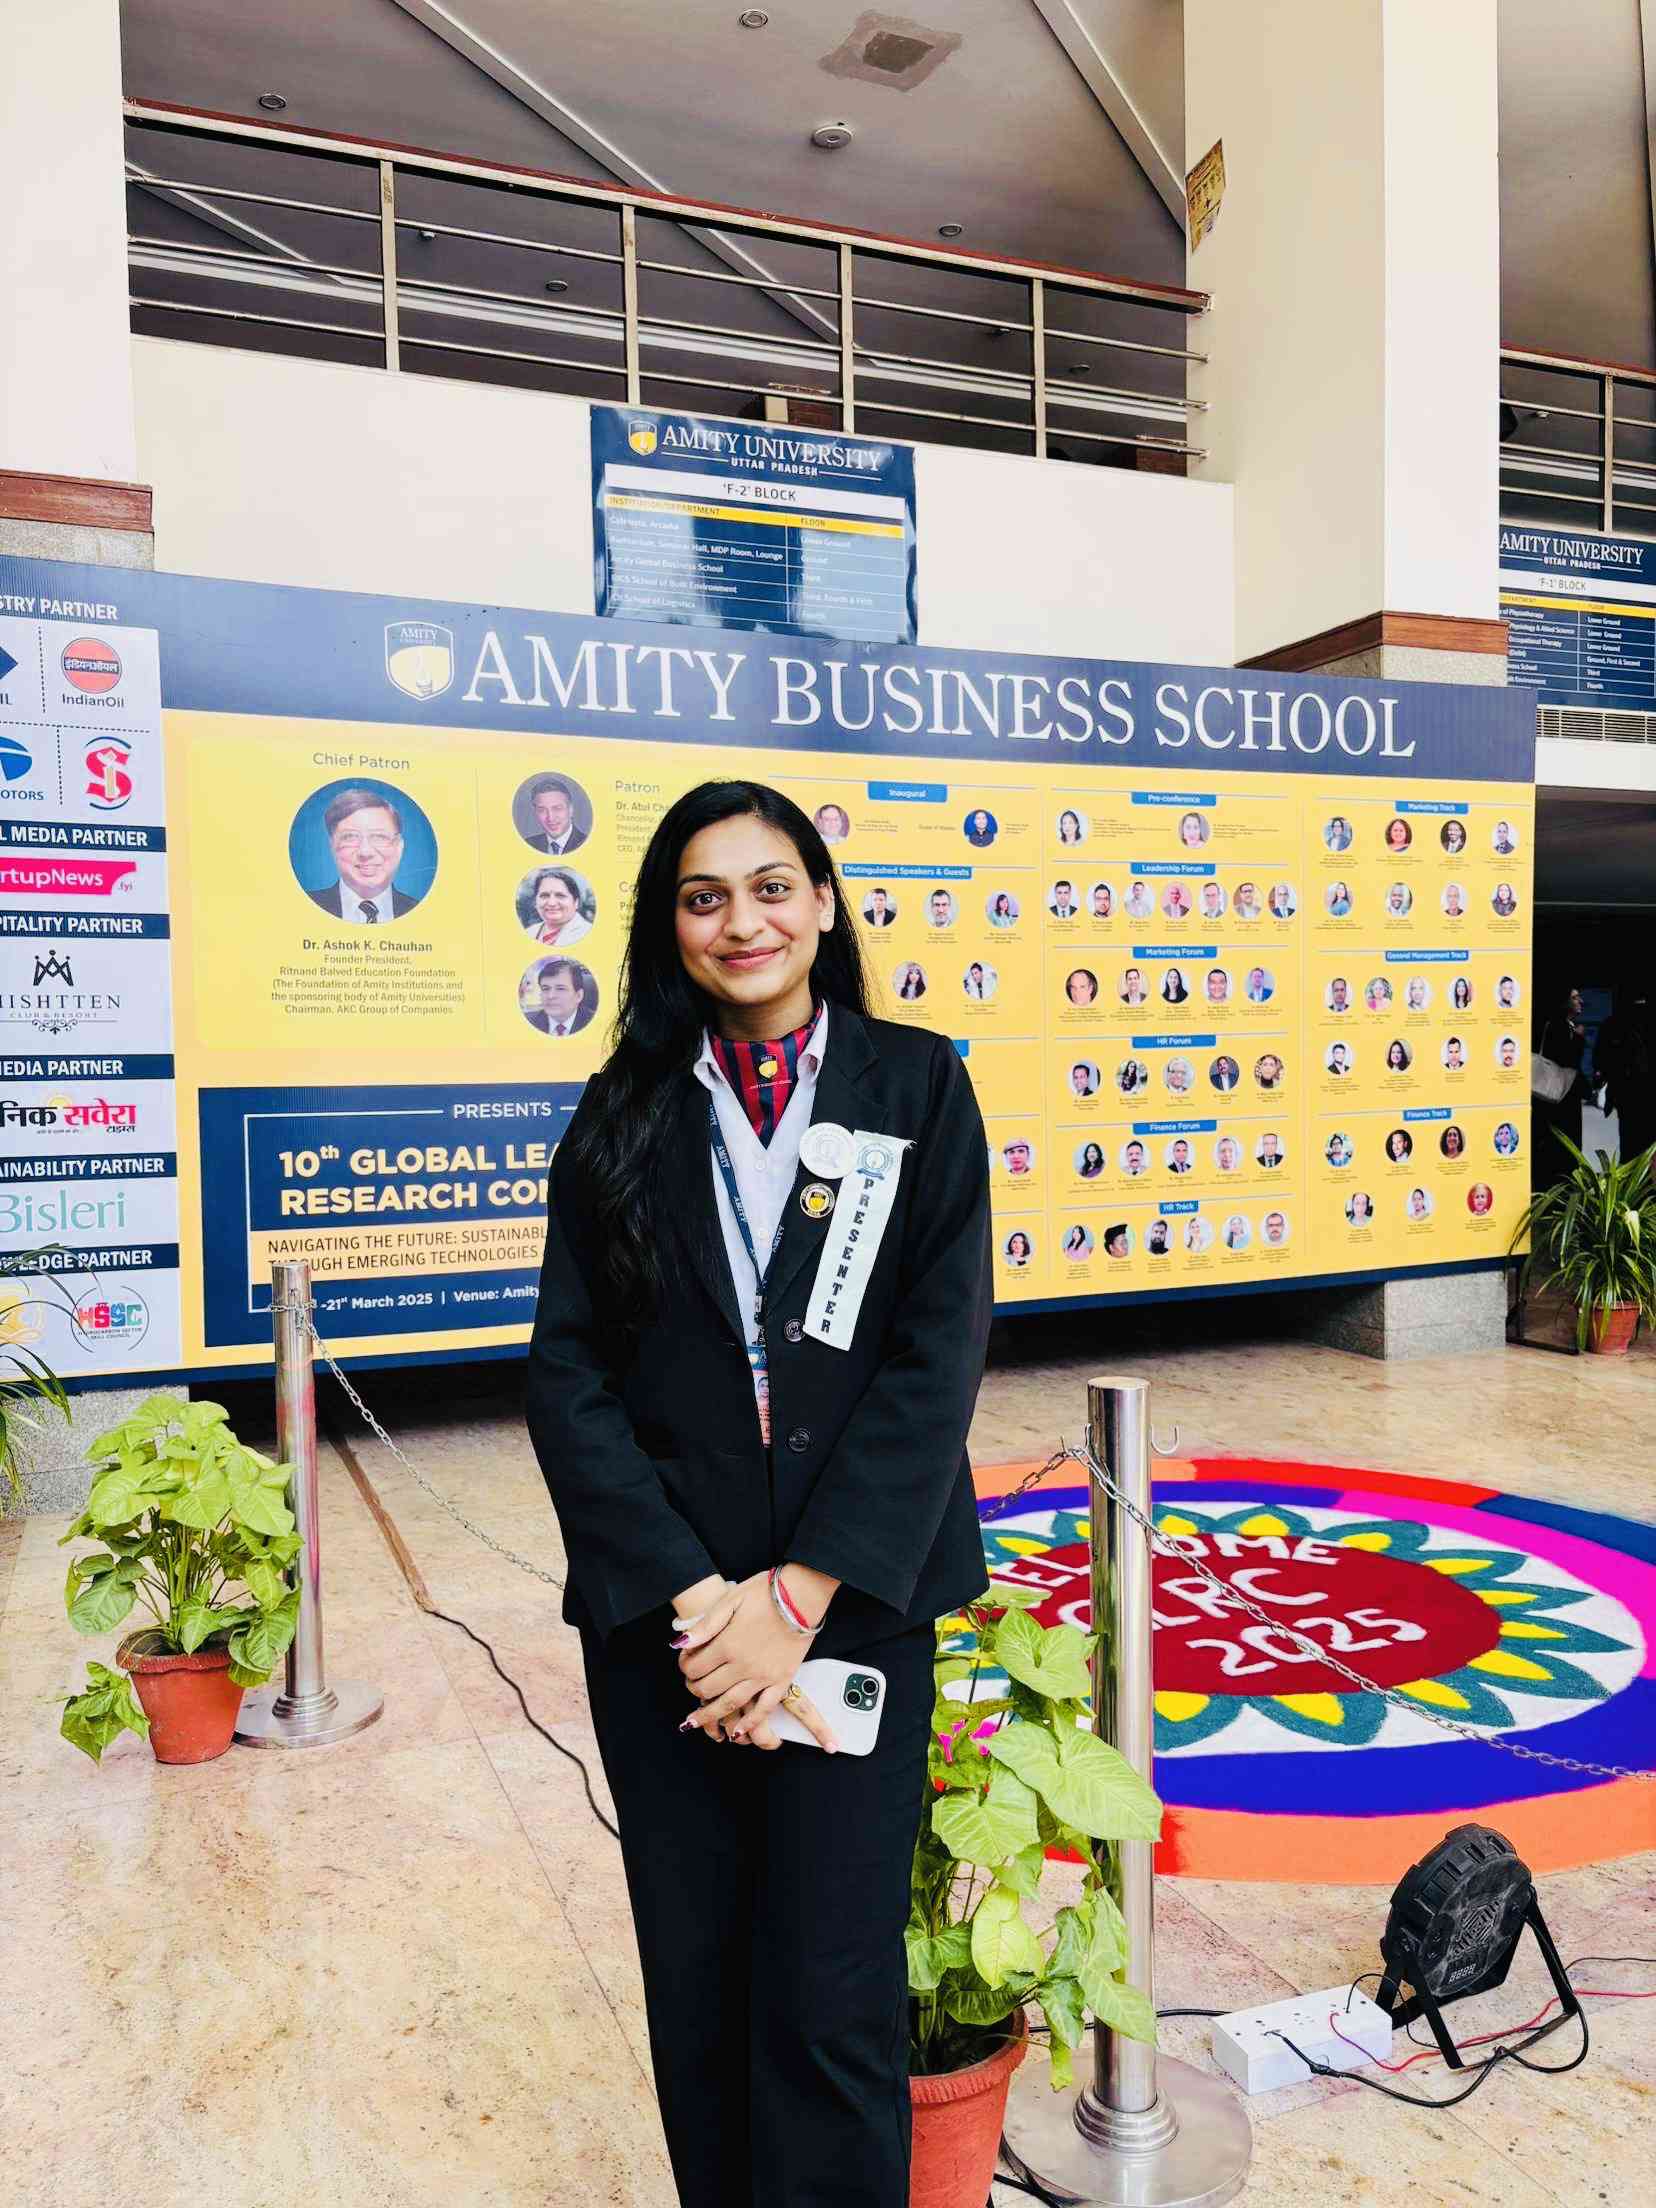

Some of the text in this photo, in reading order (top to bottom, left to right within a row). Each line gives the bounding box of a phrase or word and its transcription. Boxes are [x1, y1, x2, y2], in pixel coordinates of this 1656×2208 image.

[662, 425, 881, 471] AMITY UNIVERSITY
[731, 457, 818, 476] UTTAR PRADESH
[755, 486, 797, 501] BLOCK
[756, 549, 785, 562] Lounge
[1499, 532, 1644, 565] AMITY UNIVERSITY
[697, 562, 725, 574] School
[1570, 559, 1601, 570] PRADESH
[1558, 580, 1587, 591] BLOCK
[40, 598, 119, 621] PARTNER
[400, 627, 438, 640] AMITY
[62, 693, 125, 708] IndianOil
[462, 630, 1417, 758] AMITY BUSINESS SCHOOL
[312, 752, 411, 771] Chief Patron
[615, 780, 661, 794] Patron
[616, 801, 630, 811] Dr.
[11, 826, 69, 846] MEDIA
[71, 828, 149, 848] PARTNER
[844, 865, 898, 877] Distinguished
[1142, 863, 1204, 874] Leadership Forum
[67, 917, 143, 934] PARTNER
[303, 939, 433, 953] Dr. Ashok K. Chauhan
[1146, 948, 1205, 957] Marketing Forum
[324, 954, 364, 964] Founder
[280, 967, 456, 978] Ritnand Balved Education Foundation
[272, 979, 464, 991] (The Foundation of Amity Institutions and
[0, 994, 121, 1009] ISHTTEN
[272, 992, 288, 1002] the
[289, 992, 342, 1004] sponsoring
[344, 992, 368, 1004] body
[370, 992, 379, 1002] of
[381, 992, 407, 1004] Amity
[337, 1005, 357, 1015] AKC
[359, 1005, 388, 1017] Group
[390, 1005, 400, 1015] of
[401, 1005, 454, 1017] Companies
[1156, 1037, 1192, 1046] HR Forum
[0, 1059, 124, 1077] EDIA PARTNER
[63, 1098, 136, 1127] सवेरा
[453, 1101, 553, 1120] PRESENTS
[91, 1156, 165, 1176] PARTNER
[350, 1145, 497, 1177] GLOBAL
[280, 1182, 478, 1217] RESEARCH
[0, 1189, 126, 1234] Bisleri
[267, 1233, 361, 1255] NAVIGATING
[366, 1234, 394, 1250] THE
[397, 1230, 458, 1248] FUTURE:
[78, 1250, 152, 1268] PARTNER
[347, 1251, 427, 1270] EMERGING
[430, 1244, 540, 1265] TECHNOLOGIES
[820, 1177, 876, 1334] PRESENTER
[351, 1294, 395, 1310] March
[397, 1292, 434, 1307] 2025
[453, 1288, 500, 1304] Venue:
[79, 1303, 142, 1329] HSSC
[1185, 1608, 1429, 1678] 2025
